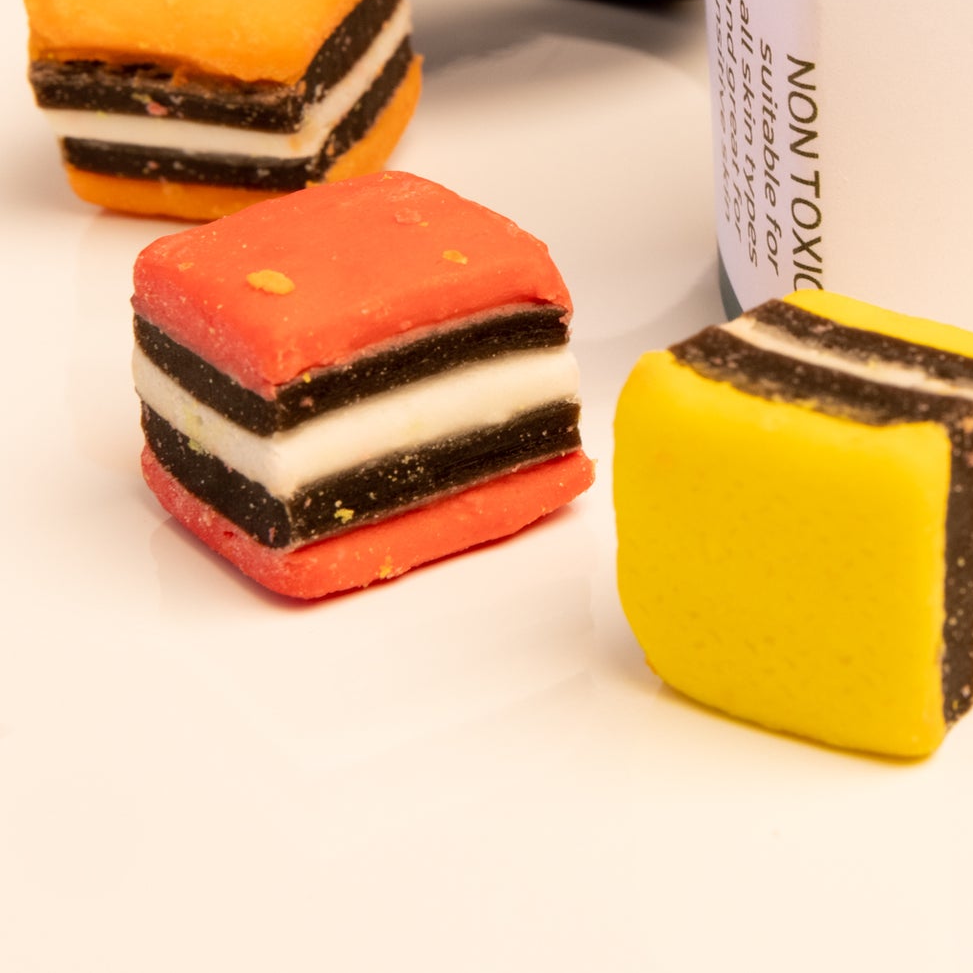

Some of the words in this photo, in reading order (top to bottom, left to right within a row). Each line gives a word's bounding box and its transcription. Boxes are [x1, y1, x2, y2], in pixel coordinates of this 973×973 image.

[740, 0, 754, 54] all
[727, 63, 740, 175] great
[742, 58, 756, 146] skin
[760, 38, 780, 208] suitable
[787, 54, 819, 159] NON
[732, 181, 742, 243] for
[743, 154, 758, 267] types
[766, 213, 782, 276] for
